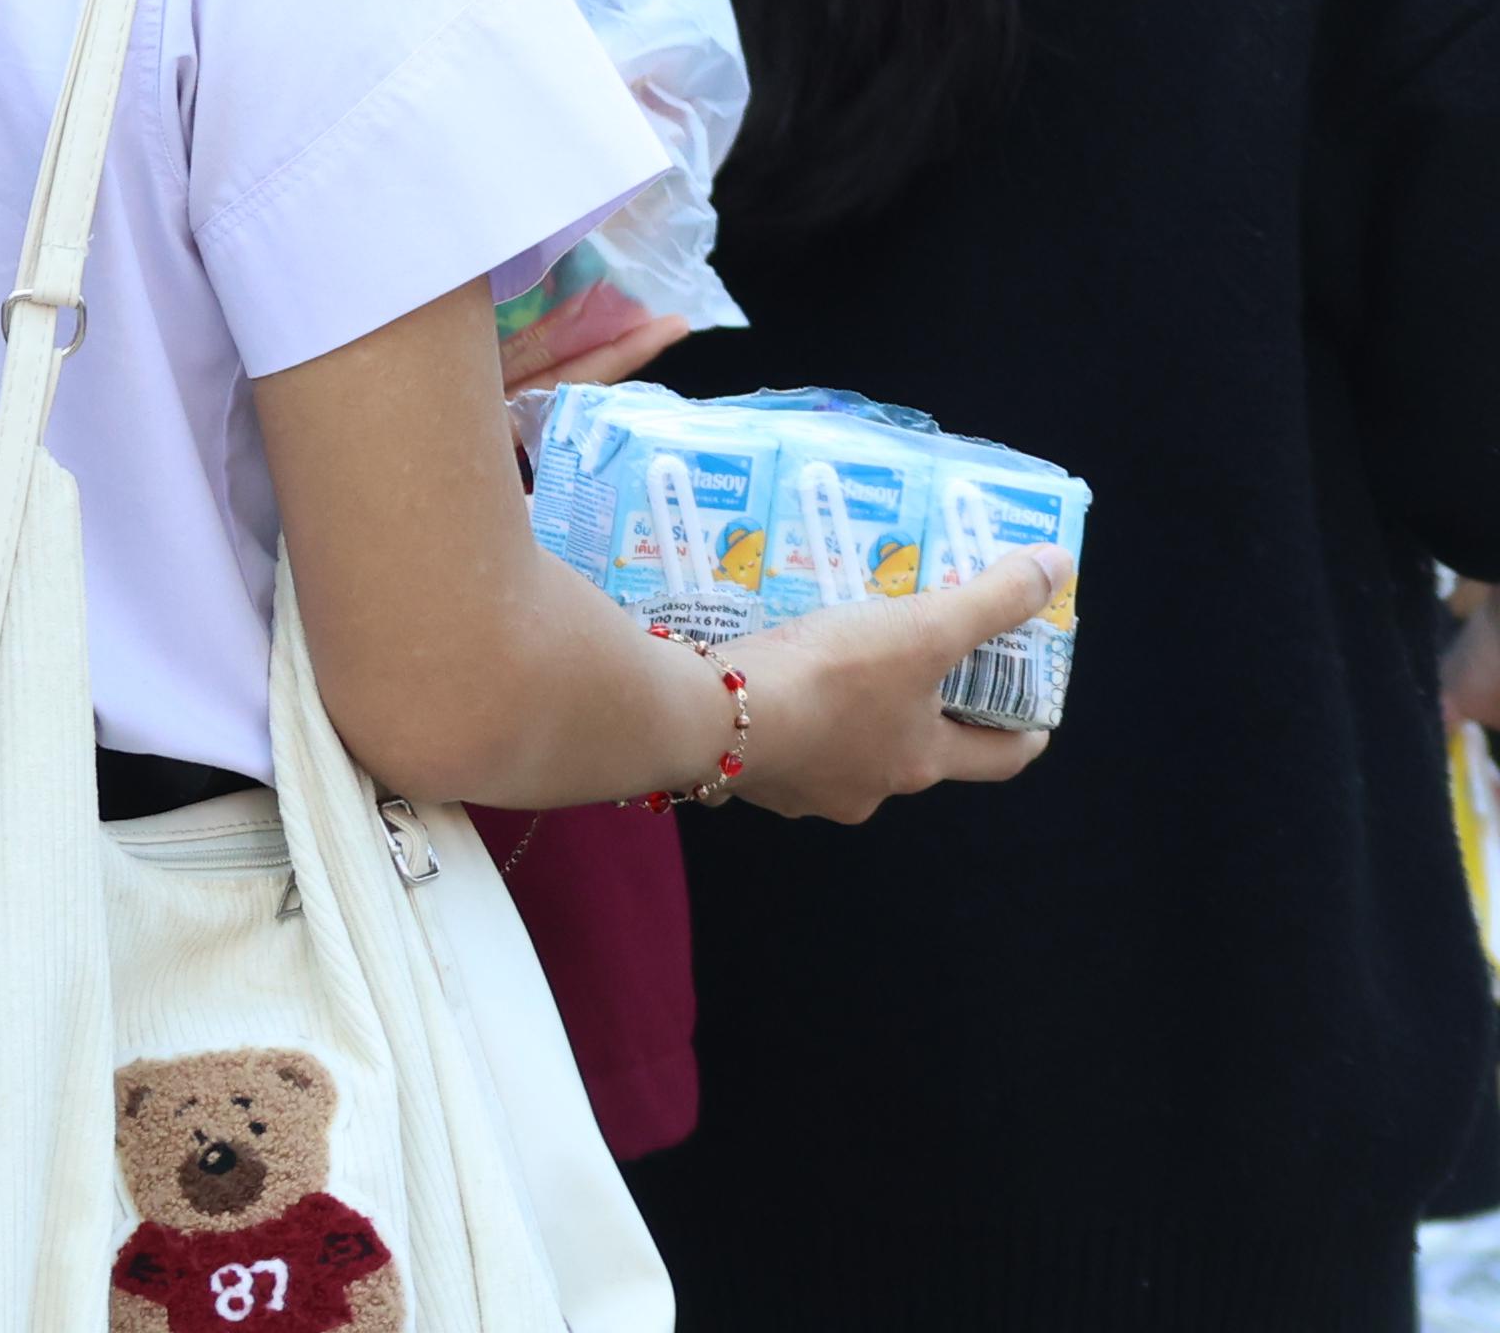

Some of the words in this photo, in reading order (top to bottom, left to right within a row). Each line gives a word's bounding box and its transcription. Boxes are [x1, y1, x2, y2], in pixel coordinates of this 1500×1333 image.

[642, 601, 693, 615] Lactasoy
[703, 616, 712, 626] 6
[714, 617, 741, 629] Packs
[996, 636, 1029, 652] Packs
[210, 1257, 290, 1322] 87
